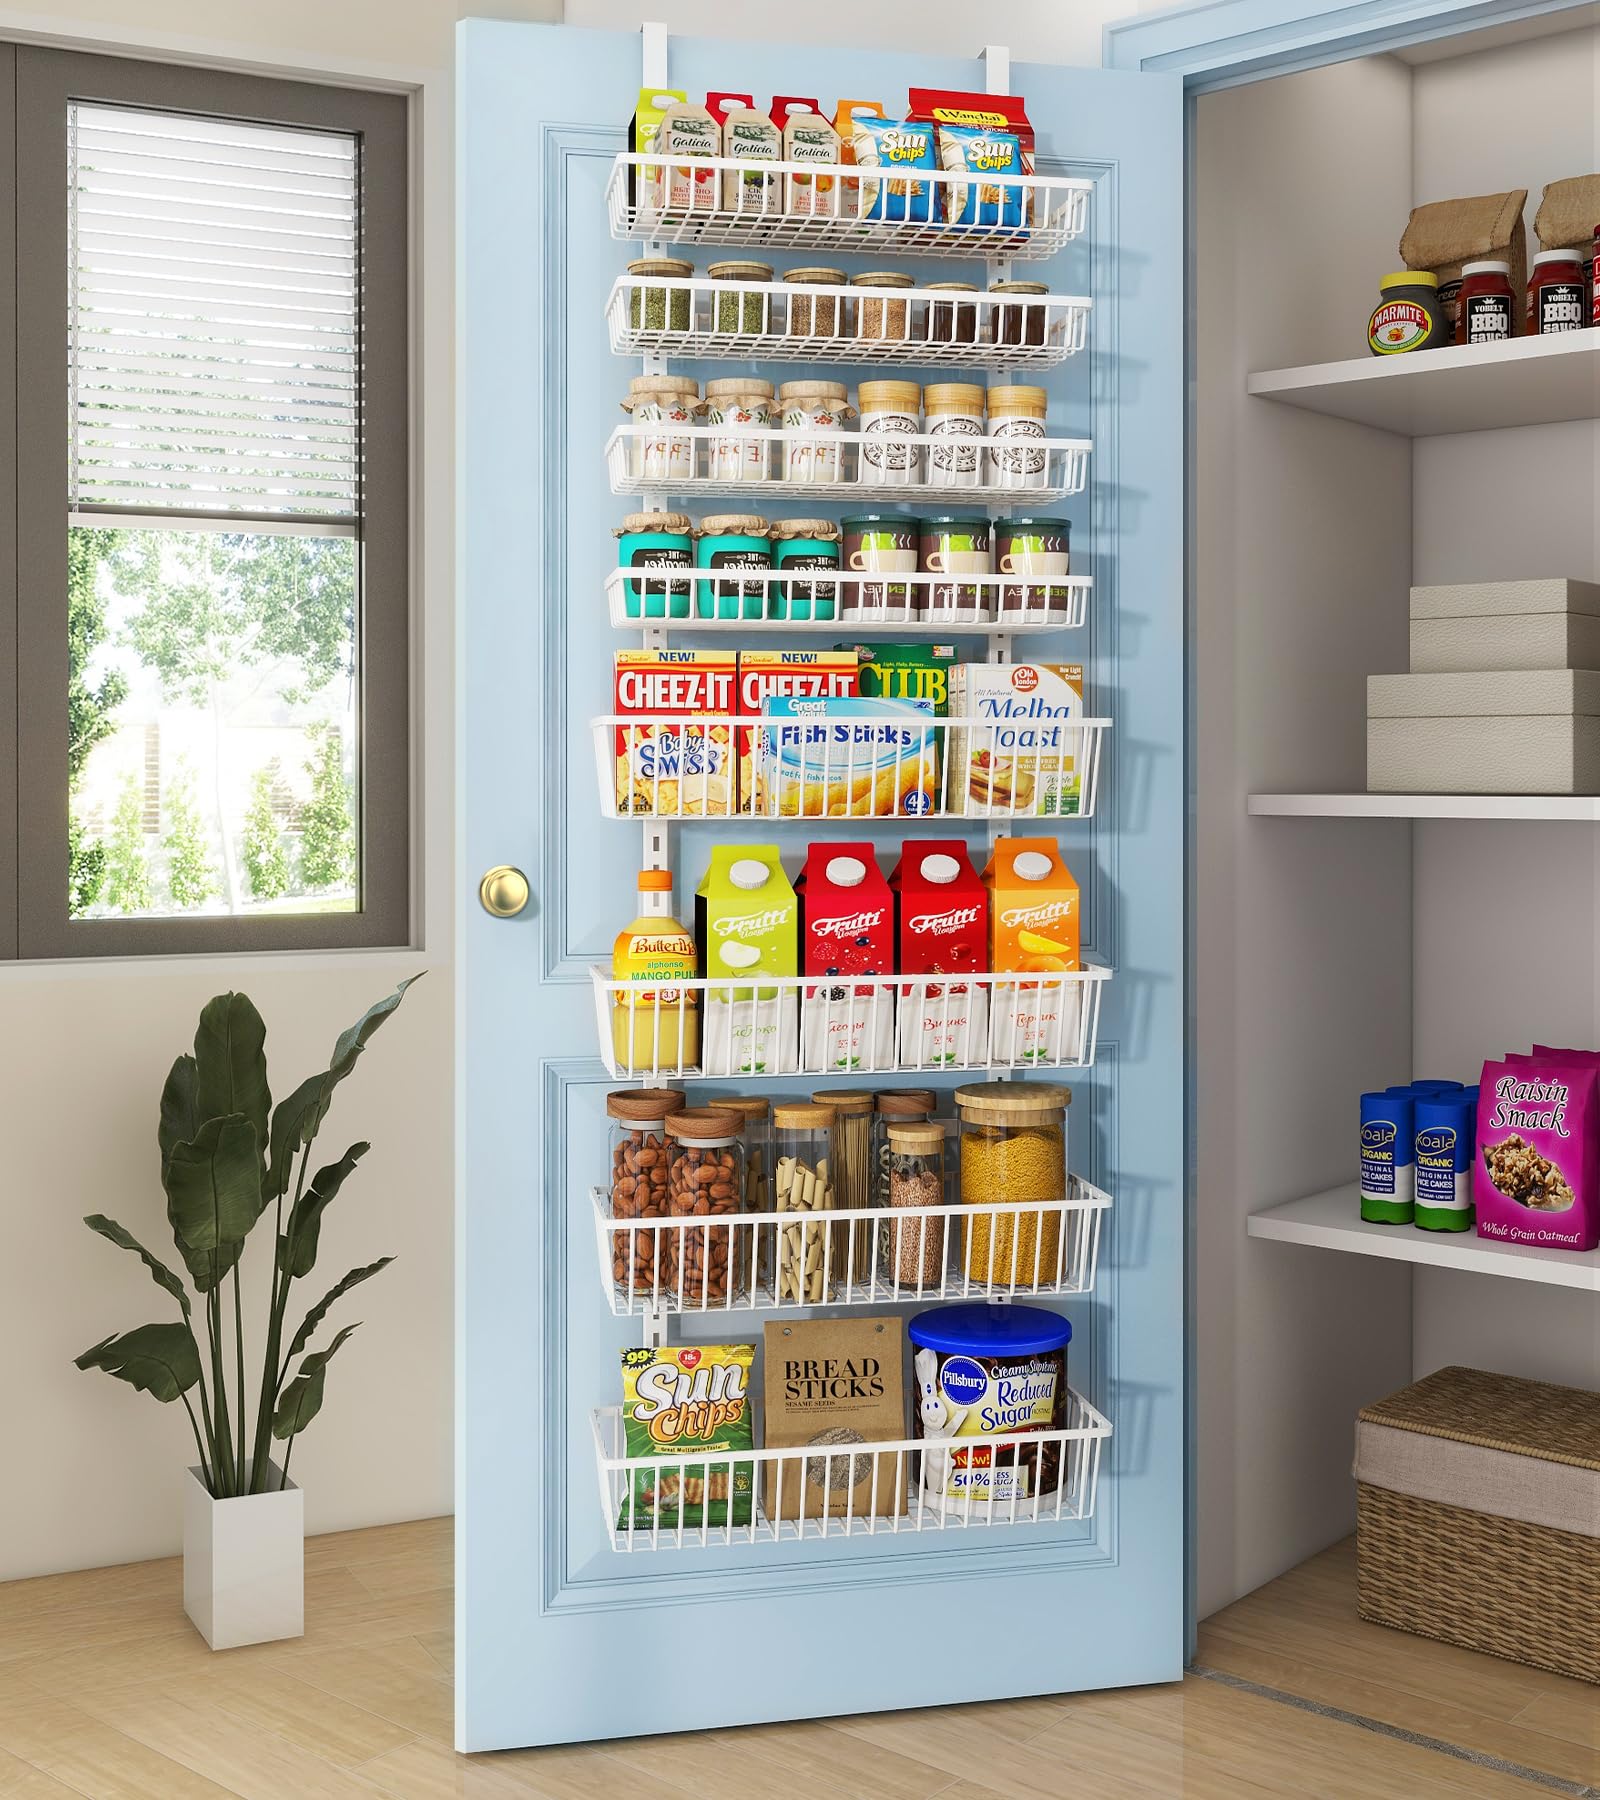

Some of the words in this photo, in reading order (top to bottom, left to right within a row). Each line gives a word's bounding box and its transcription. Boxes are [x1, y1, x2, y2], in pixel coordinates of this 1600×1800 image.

[940, 109, 1001, 122] Wanchai
[672, 136, 712, 149] Galicia
[734, 143, 771, 155] Galicia
[880, 130, 926, 152] Sun
[968, 140, 1013, 161] Sun
[793, 147, 832, 158] Galicia
[889, 147, 926, 163] Chips
[976, 155, 1012, 171] Chips
[1374, 305, 1422, 328] MARMITE
[1471, 313, 1508, 333] BBQ
[1544, 303, 1581, 323] BBQ
[1471, 332, 1508, 344] sauce
[1544, 322, 1582, 334] sauce
[658, 652, 696, 662] NEW!
[781, 653, 817, 663] NEW!
[1013, 671, 1037, 688] London
[1018, 668, 1033, 678] Old
[618, 671, 734, 709] CHEEZ-IT
[859, 663, 947, 705] CLUB
[788, 698, 827, 712] Great
[781, 725, 826, 746] Fish
[834, 724, 912, 746] Sticks
[713, 906, 792, 937] Frutti
[811, 908, 886, 937] Frutti
[909, 905, 982, 934] Frutti
[1000, 899, 1075, 928] Frutti
[631, 971, 671, 980] MANGO
[647, 961, 684, 970] alphonso
[1495, 1075, 1569, 1104] Raisin
[1489, 1102, 1571, 1137] Smack
[1417, 1156, 1454, 1168] ORGANIC
[1417, 1170, 1453, 1180] ORIGINAL
[1430, 1180, 1454, 1189] CAKES
[1482, 1221, 1508, 1236] Whole
[1510, 1226, 1535, 1240] Grain
[1537, 1229, 1581, 1243] Oatmeal
[784, 1358, 880, 1380] BREAD
[990, 1365, 1029, 1380] Creamy
[1028, 1359, 1058, 1376] Supreme
[785, 1377, 884, 1400] STICKS
[943, 1370, 986, 1390] Pillsbury
[633, 1363, 746, 1421] Sun
[997, 1376, 1054, 1407] Reduced
[650, 1399, 744, 1442] Chips
[980, 1402, 1036, 1431] Sugar
